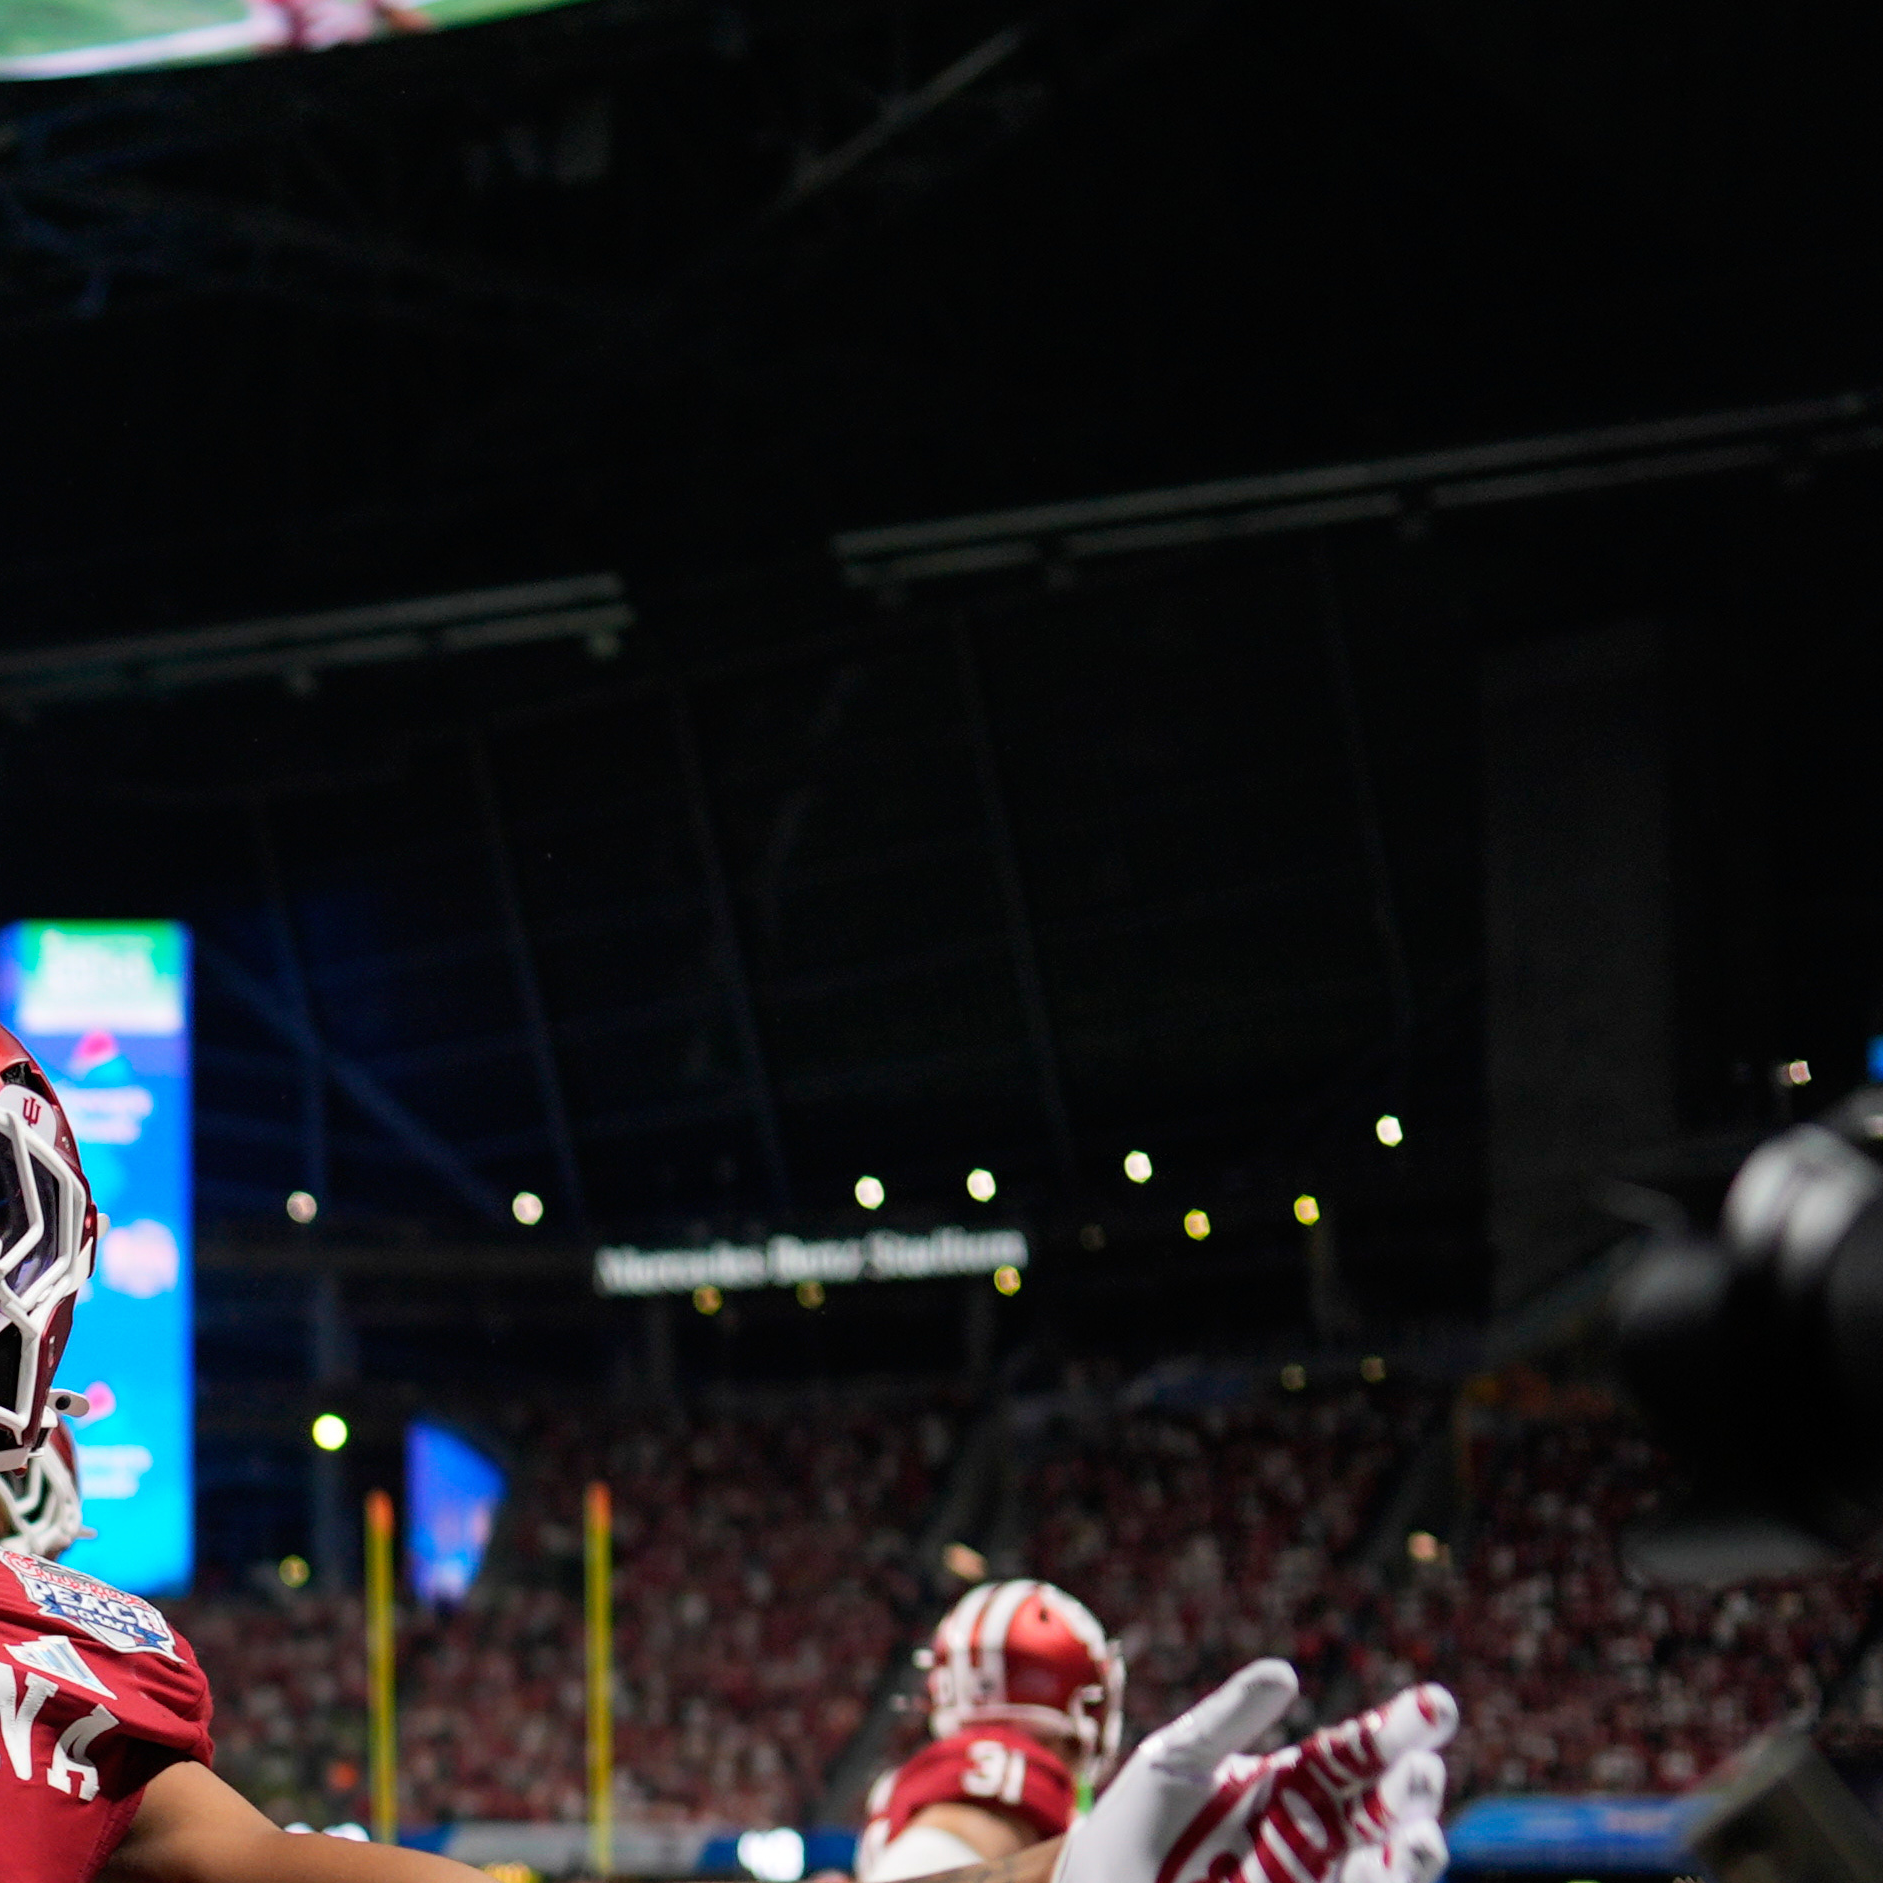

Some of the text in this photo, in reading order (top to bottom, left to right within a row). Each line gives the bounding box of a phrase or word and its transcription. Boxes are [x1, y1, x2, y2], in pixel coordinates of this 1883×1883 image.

[34, 1580, 167, 1637] PEACH
[63, 1604, 143, 1639] BOWL
[960, 1740, 1027, 1804] 31
